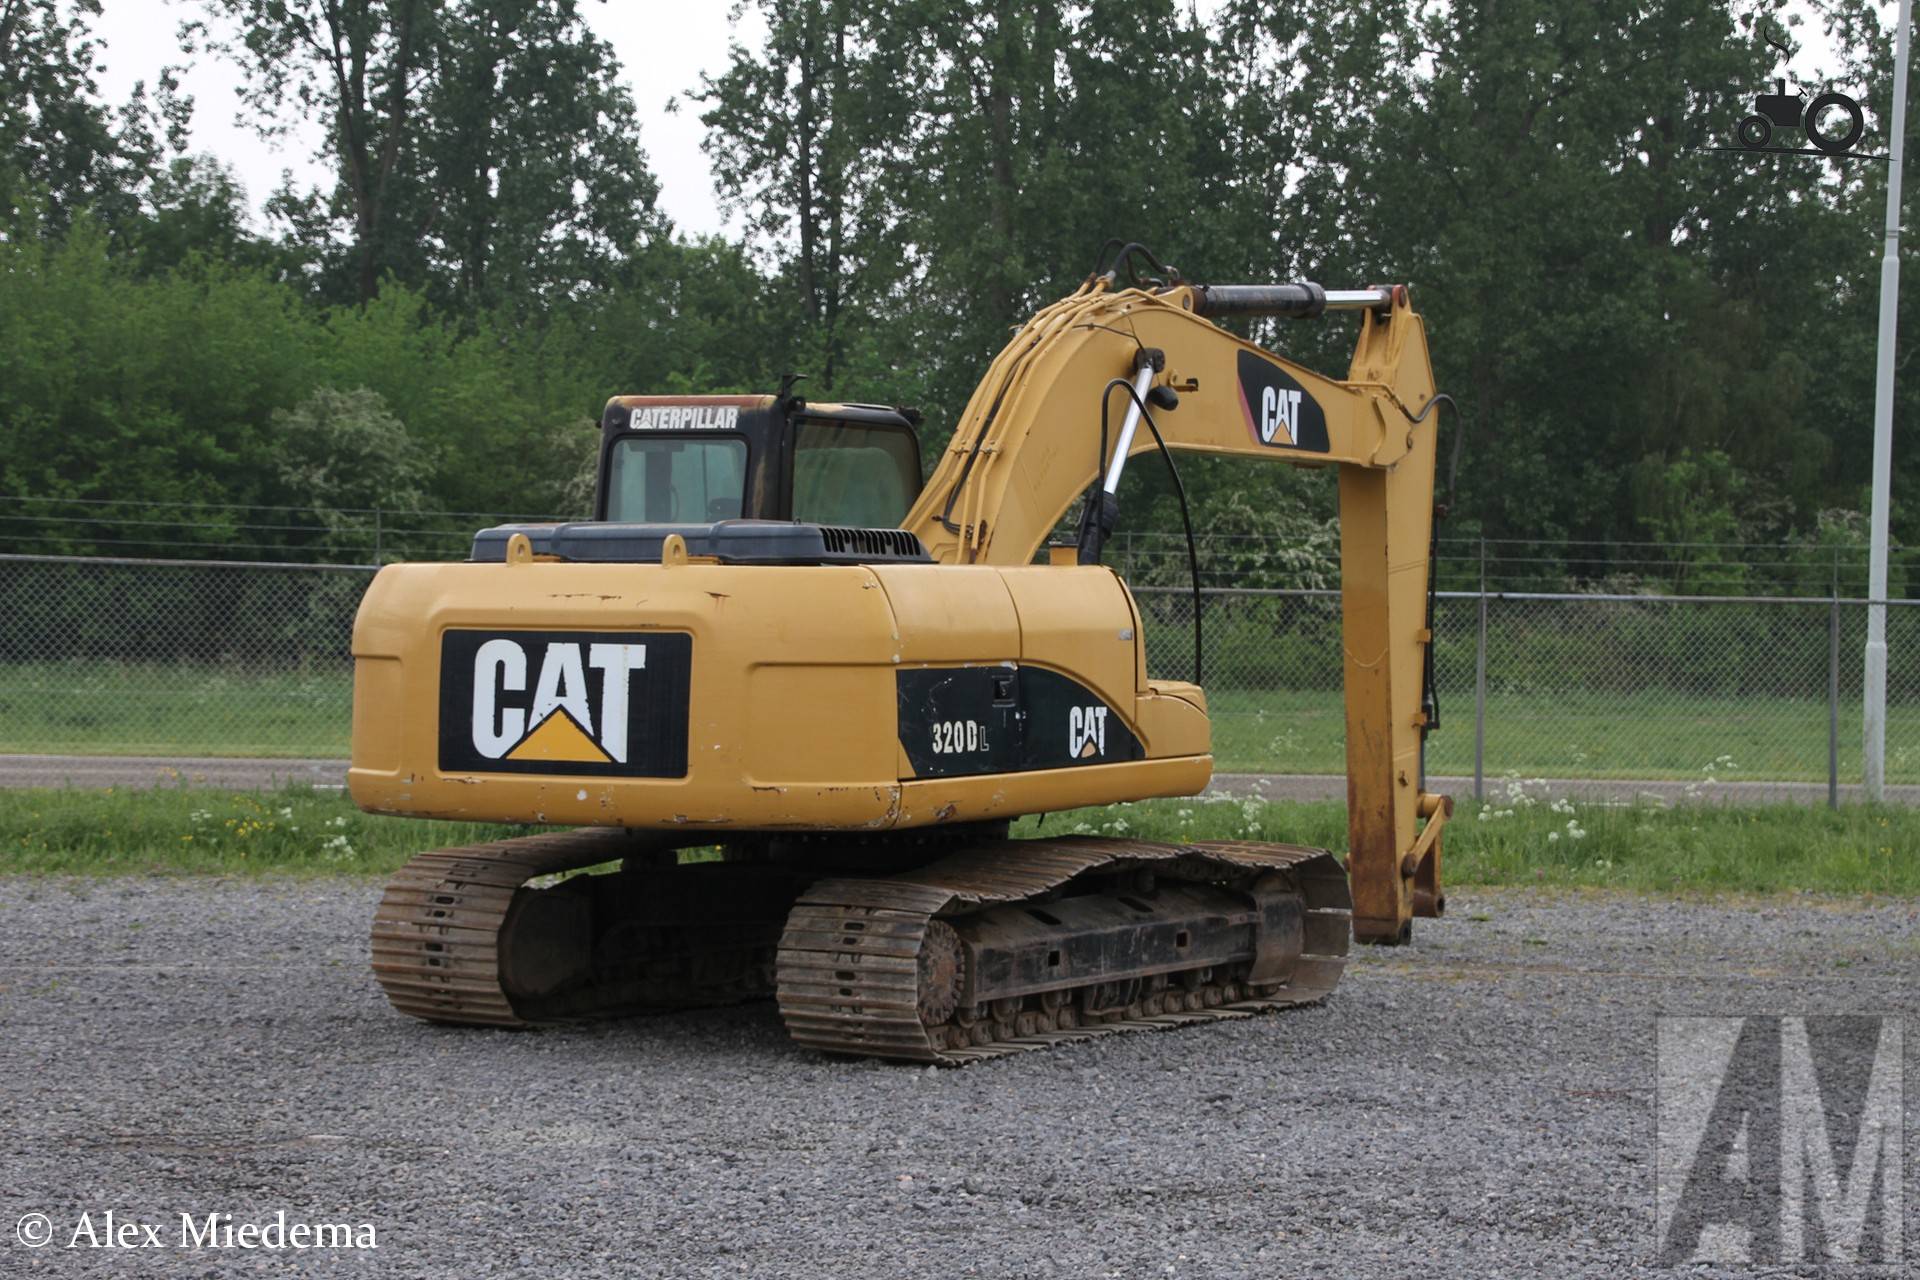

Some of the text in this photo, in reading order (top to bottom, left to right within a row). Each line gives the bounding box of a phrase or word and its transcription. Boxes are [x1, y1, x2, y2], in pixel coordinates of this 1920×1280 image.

[629, 406, 740, 431] CATERPILLAR
[1261, 386, 1301, 446] CAT
[472, 639, 647, 764] CAT
[1069, 706, 1108, 759] CAT
